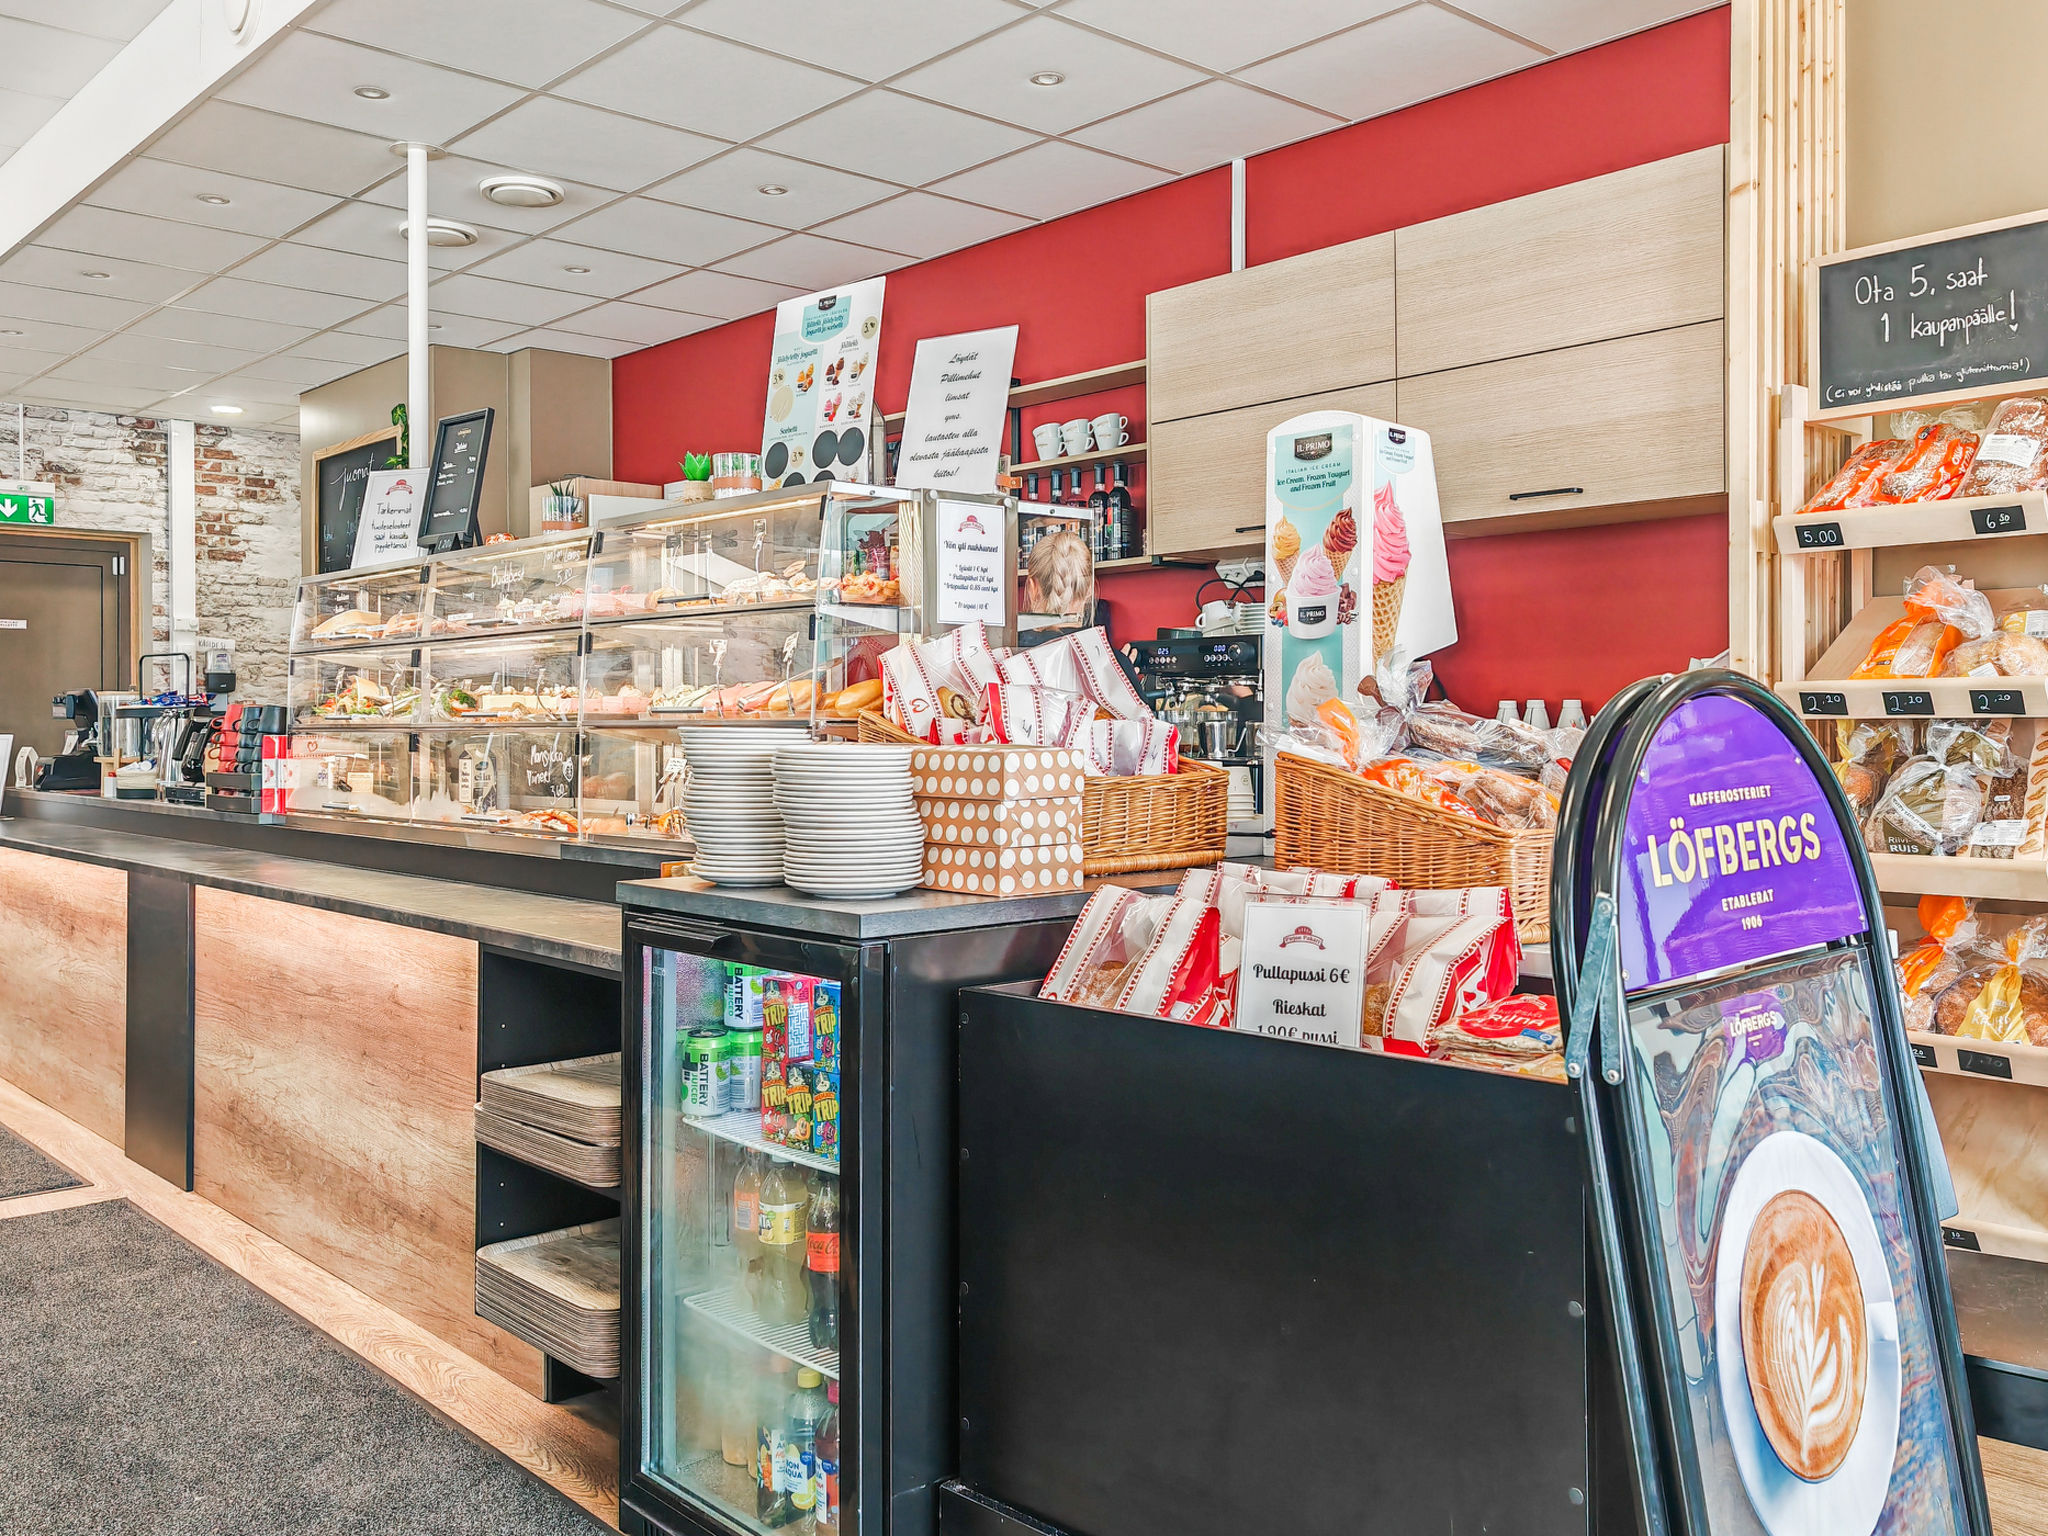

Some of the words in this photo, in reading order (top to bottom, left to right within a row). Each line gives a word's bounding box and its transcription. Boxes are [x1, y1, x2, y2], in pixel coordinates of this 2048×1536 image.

[1855, 275, 1895, 304] Ota
[1946, 256, 1989, 290] saat
[1881, 312, 1890, 342] 1
[1911, 289, 2016, 347] kaupanpäälle!
[948, 352, 979, 365] Löydät
[940, 370, 982, 385] Pillimehut
[945, 391, 970, 402] limsat
[1865, 380, 1903, 398] yhdistää
[944, 413, 962, 423] yms.
[925, 430, 960, 442] lautasten
[962, 428, 978, 438] alla
[909, 450, 940, 462] olevasta
[941, 445, 989, 461] jääkaapista
[1305, 440, 1330, 452] PRIMO
[933, 466, 960, 478] kiitos!
[1321, 462, 1341, 470] CREAM
[1290, 484, 1301, 493] and
[1301, 482, 1321, 491] Frozen
[1321, 480, 1336, 488] Fruit
[1306, 473, 1326, 482] Frozen
[1803, 530, 1837, 543] 5.00
[1688, 784, 1772, 807] KAFFEROSTERIET
[1646, 812, 1822, 889] LÖFBERGS
[1889, 844, 1920, 853] RUIS
[1720, 888, 1775, 912] ETABLERAT
[1740, 914, 1764, 931] 1906
[1253, 963, 1327, 985] Pullapussi
[1329, 967, 1351, 984] 6€
[734, 967, 744, 1020] BATTERY
[763, 1003, 787, 1027] TRIP
[1272, 998, 1328, 1018] Rieskat
[814, 1013, 836, 1036] TRIP
[1730, 1010, 1778, 1038] LÖFBERGS
[690, 1072, 699, 1105] JUICED
[699, 1053, 709, 1107] BATTERY
[762, 1084, 787, 1108] TRIP
[786, 1091, 812, 1115] TRIP
[813, 1098, 839, 1122] TRIP
